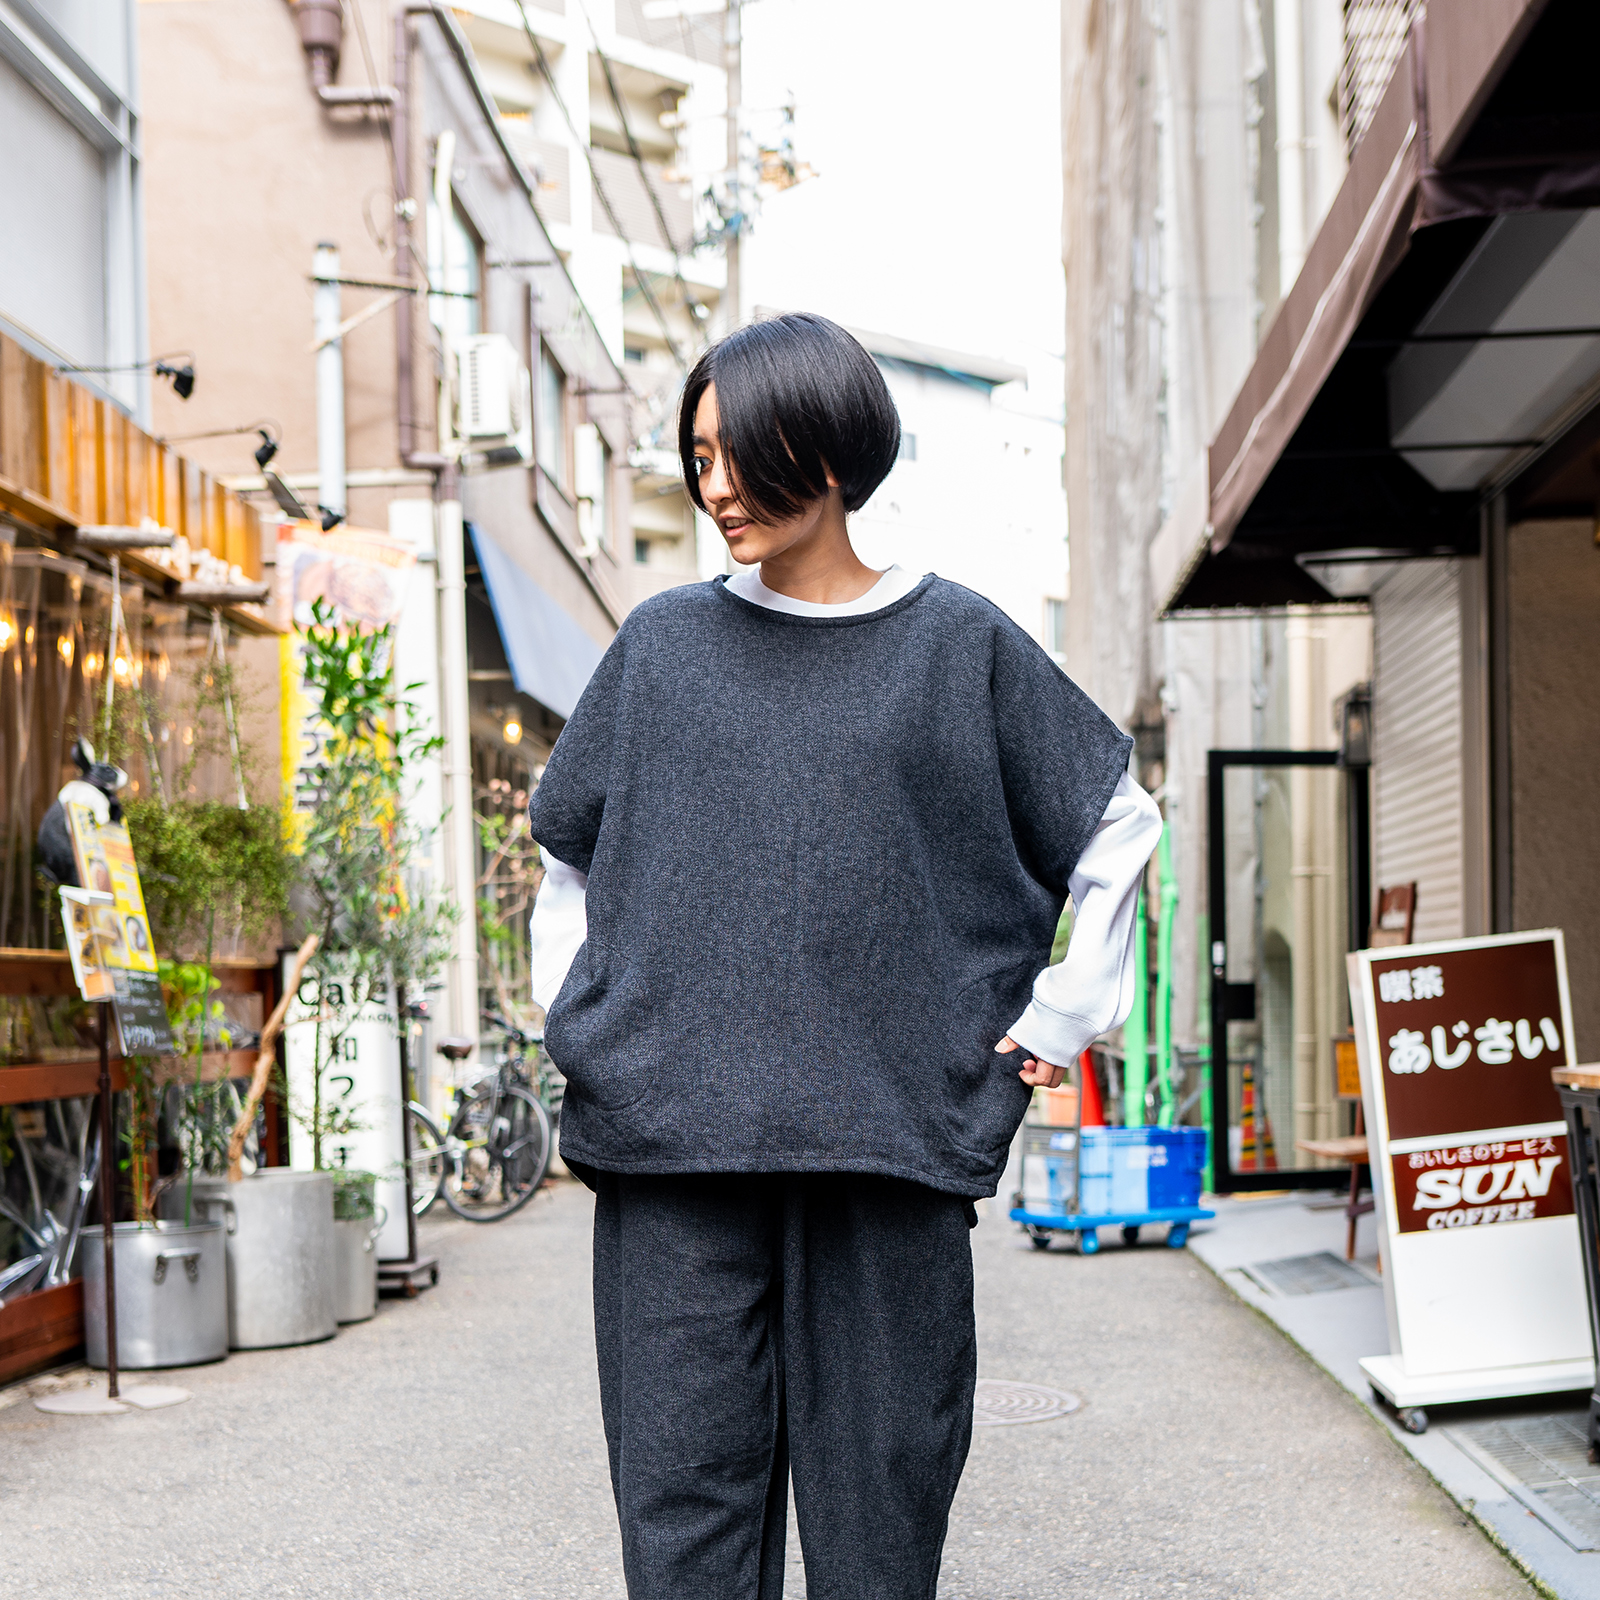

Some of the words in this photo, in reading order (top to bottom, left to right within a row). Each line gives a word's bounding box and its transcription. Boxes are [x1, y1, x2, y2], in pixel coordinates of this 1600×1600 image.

[1379, 965, 1445, 1003] 喫茶
[1388, 1017, 1560, 1075] あじさい
[1408, 1137, 1556, 1169] おいしさのサービス
[1413, 1156, 1562, 1211] SUN
[1427, 1201, 1536, 1230] COFFEE
